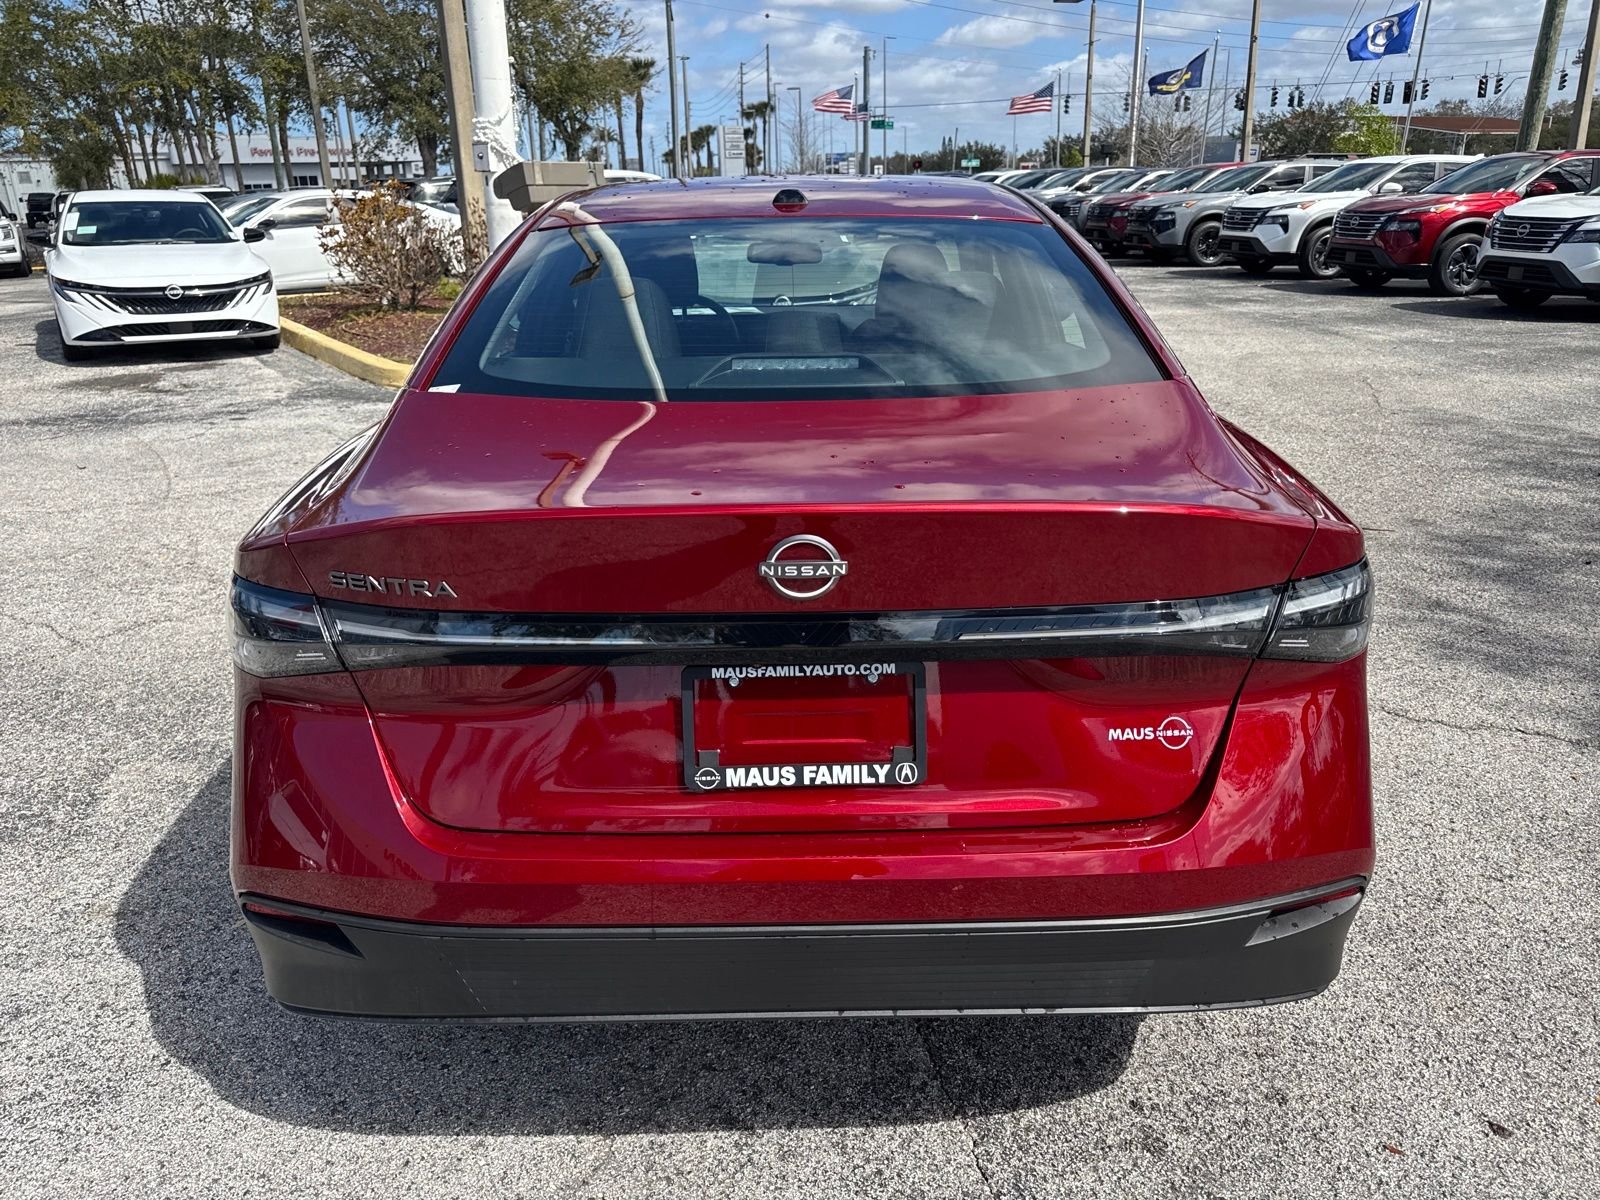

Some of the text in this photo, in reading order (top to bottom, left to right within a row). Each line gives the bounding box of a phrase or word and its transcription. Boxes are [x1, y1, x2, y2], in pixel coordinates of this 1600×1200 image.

[761, 564, 846, 576] NISSAN
[328, 570, 458, 598] SENTRA
[711, 663, 896, 679] MAUSFAMILYAUTO.COM
[1108, 727, 1194, 741] MAUS NISSAN
[725, 766, 797, 787] MAUS
[803, 764, 891, 785] FAMILY
